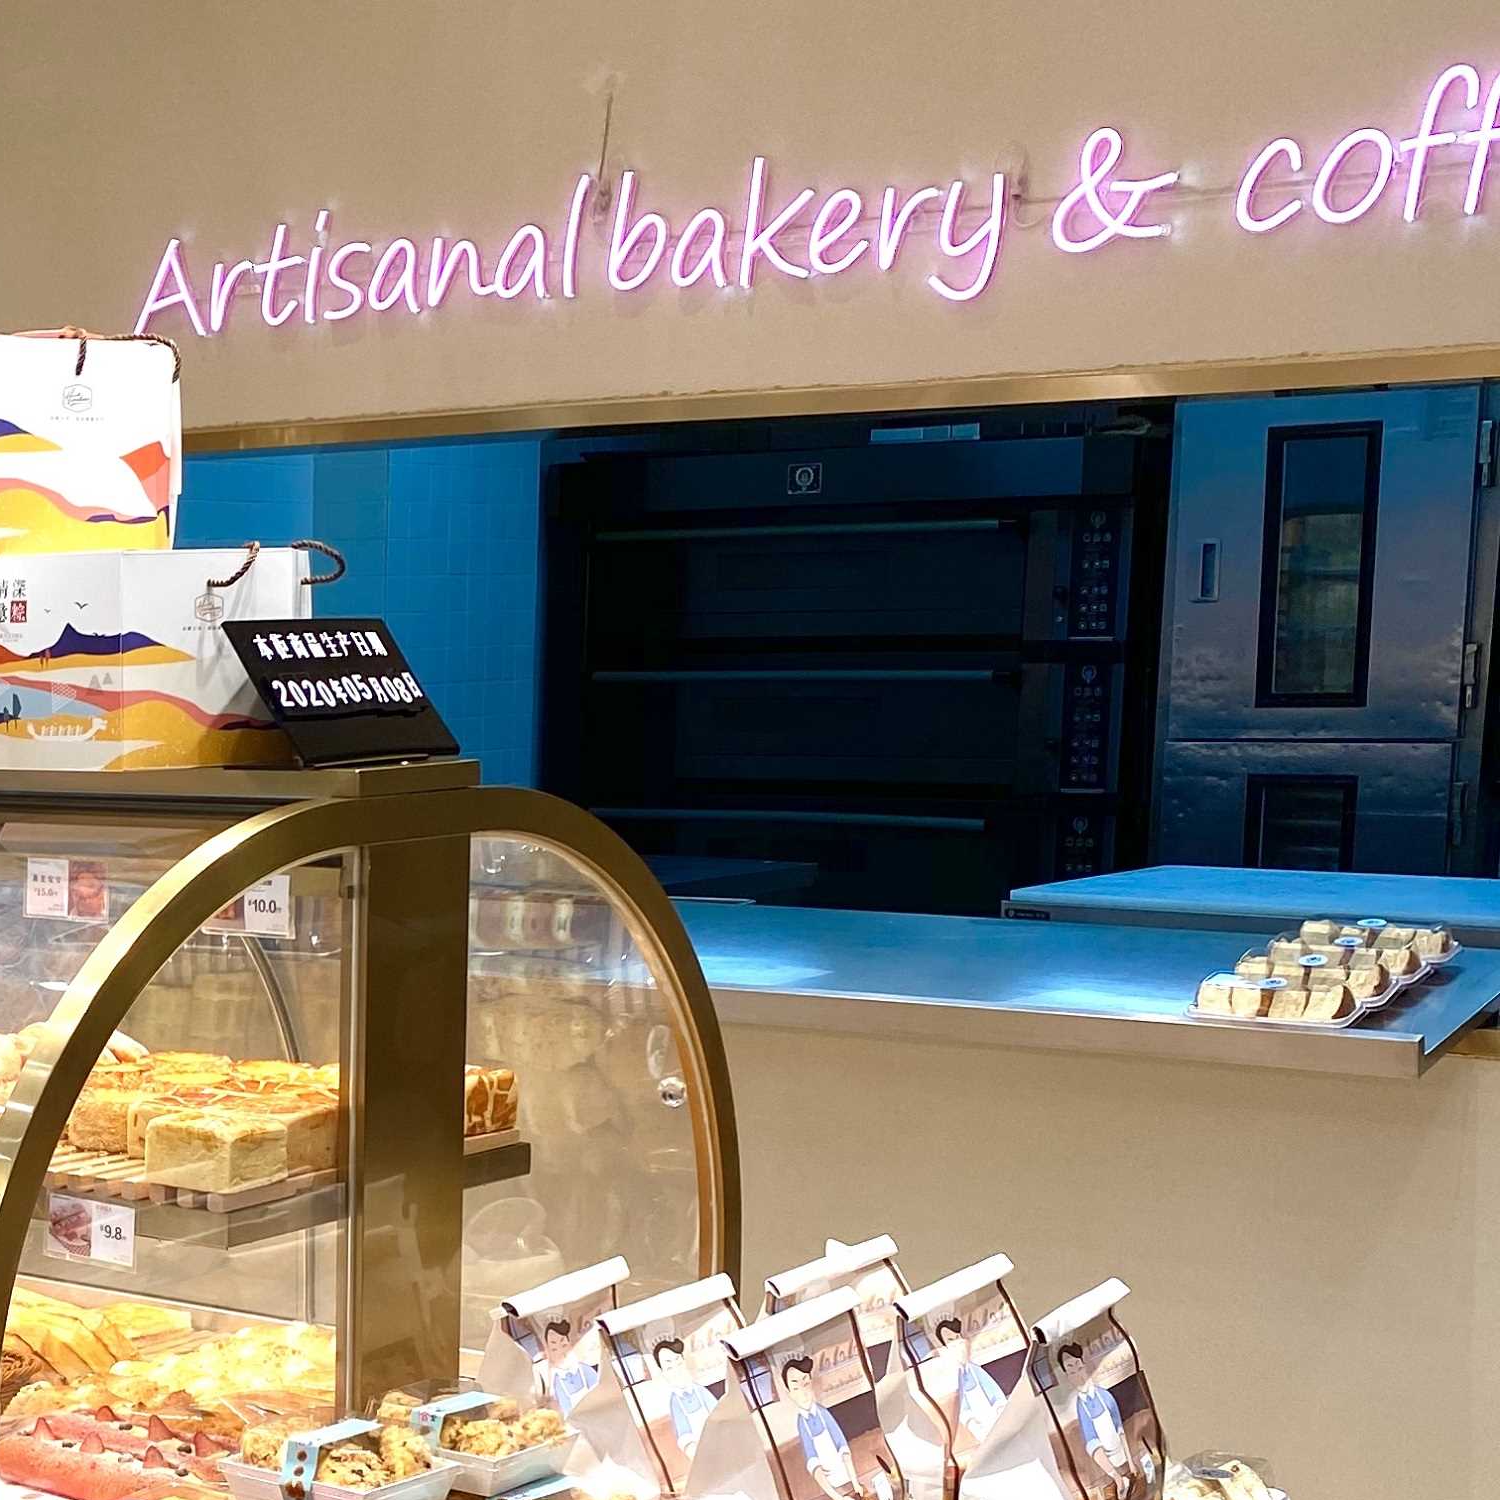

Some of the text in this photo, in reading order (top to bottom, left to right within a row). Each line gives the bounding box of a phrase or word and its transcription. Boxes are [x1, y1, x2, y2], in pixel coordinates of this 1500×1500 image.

[134, 173, 590, 337] Artisanal
[607, 155, 1007, 301] bakery
[1051, 126, 1180, 253] &
[270, 671, 424, 708] 2020年05月08日
